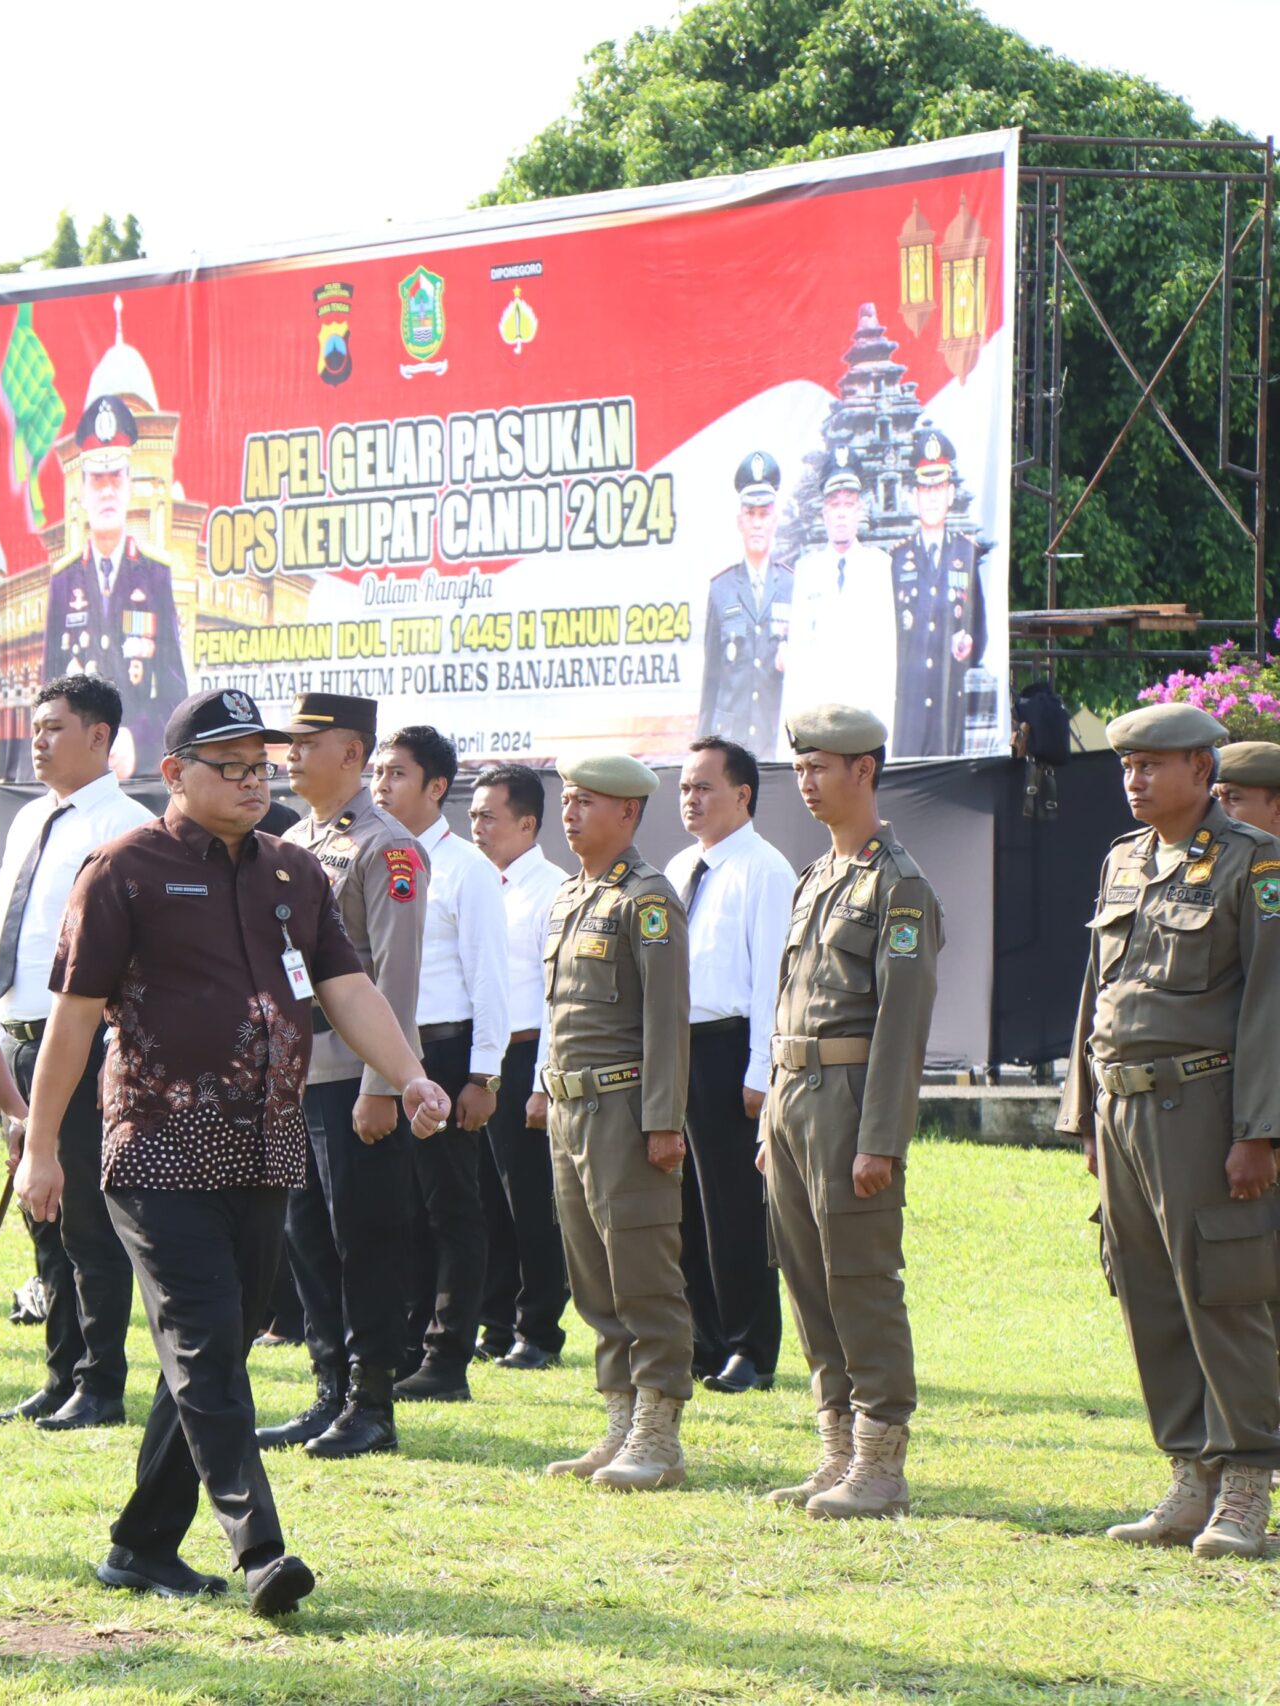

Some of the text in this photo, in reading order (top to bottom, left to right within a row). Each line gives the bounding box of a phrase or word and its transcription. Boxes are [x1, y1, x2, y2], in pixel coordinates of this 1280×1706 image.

[491, 263, 542, 280] DIPONEGORO
[245, 400, 633, 502] APEL GELAR PASUKAN
[209, 474, 676, 575] OPS KETUPAT CANDI 2024
[364, 572, 493, 609] Dalam Rangka
[194, 603, 690, 666] PENGAMANAN IDUL FITRI 1445 H TAHUN 2024
[321, 667, 395, 698] HUKUM
[399, 662, 489, 695] POLRES
[497, 653, 681, 692] BANJARNEGARA
[490, 730, 532, 753] 2024
[608, 1070, 632, 1082] POL PP
